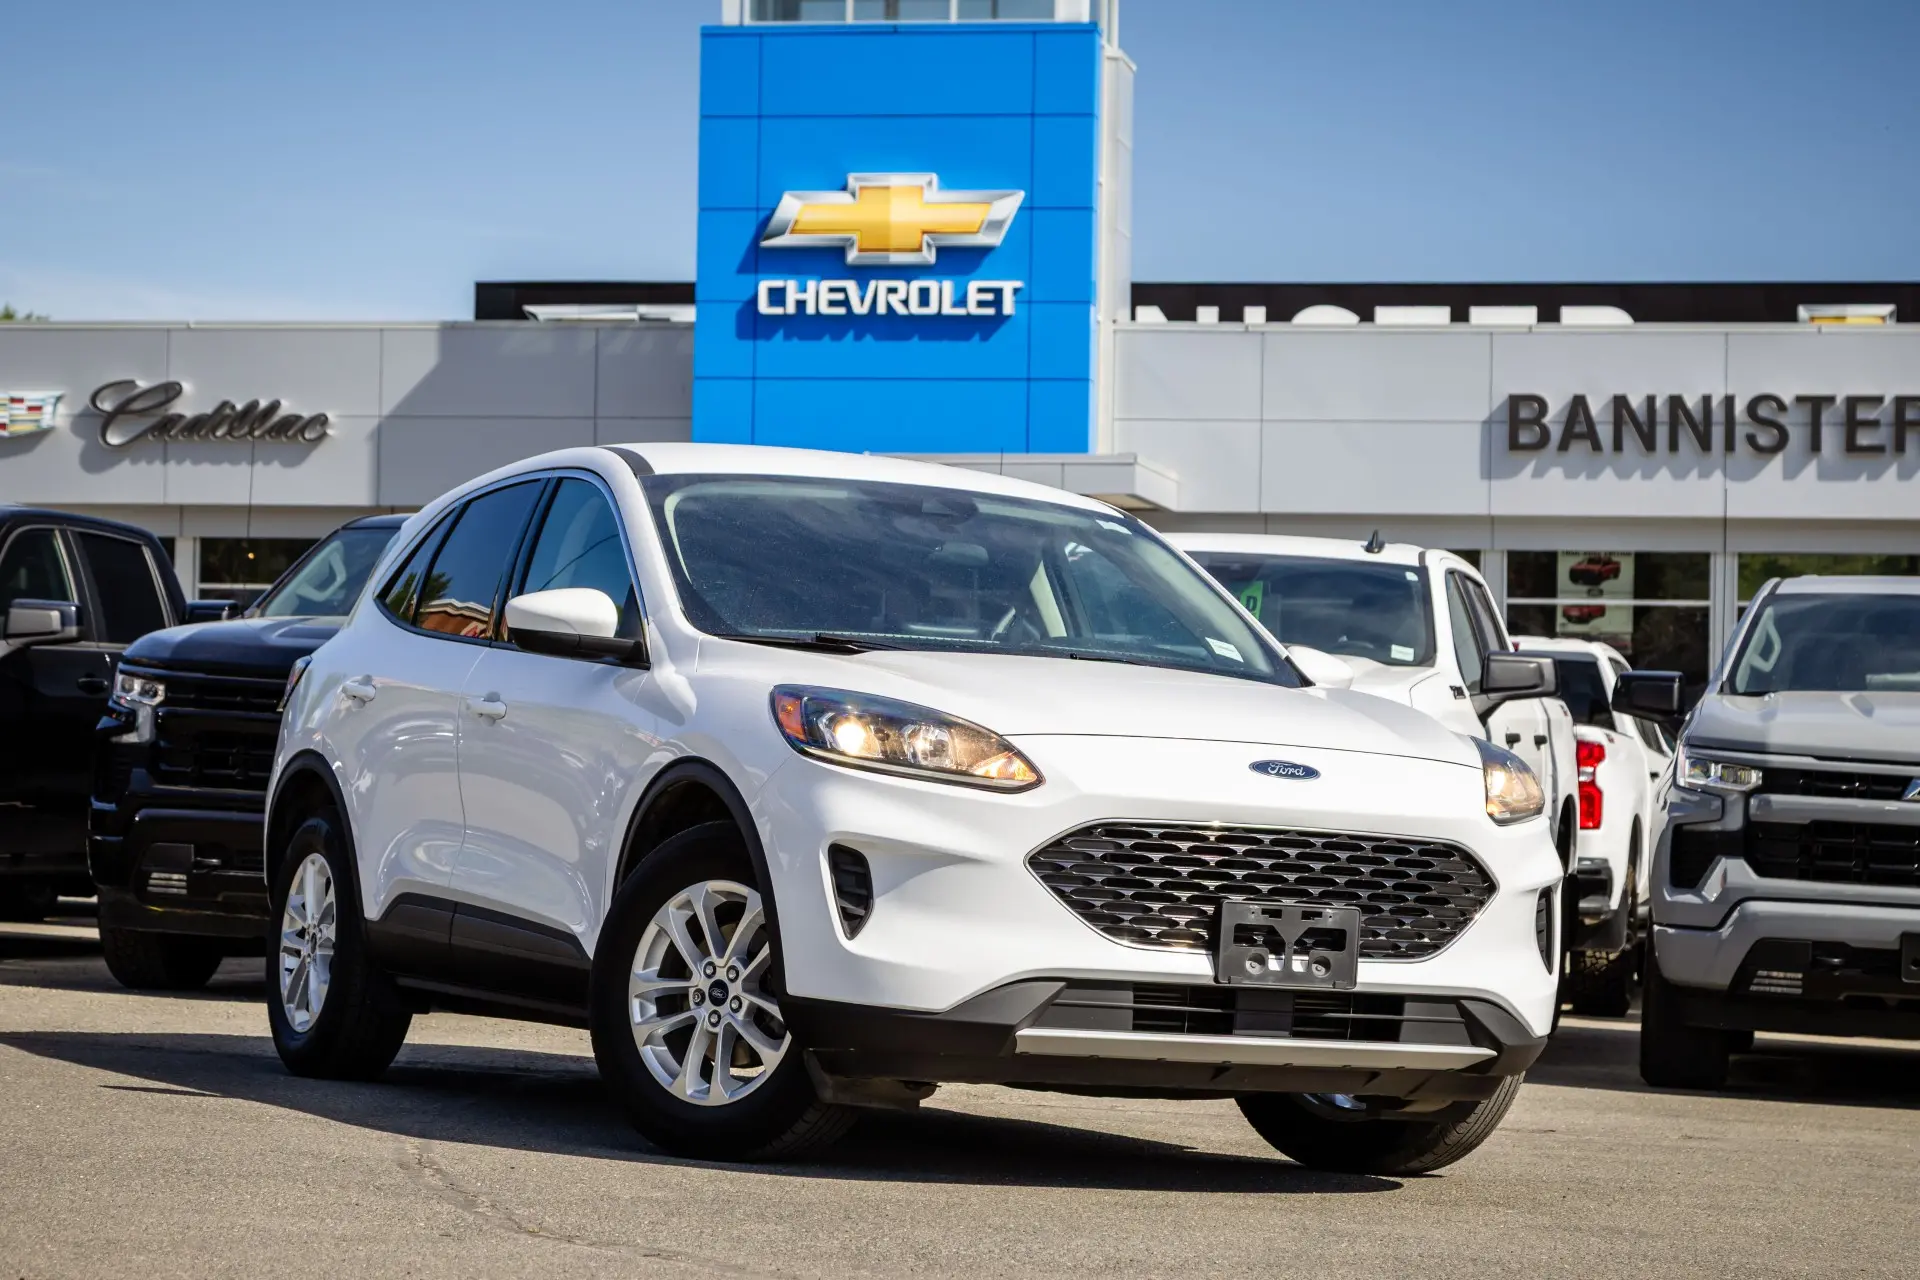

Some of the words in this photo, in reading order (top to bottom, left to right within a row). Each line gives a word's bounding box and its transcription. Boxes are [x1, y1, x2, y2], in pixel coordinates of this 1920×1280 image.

[757, 279, 1024, 316] CHEVROLET
[90, 379, 329, 446] Cadillac
[1508, 393, 1920, 454] BANNISTER
[1267, 762, 1306, 776] Ford
